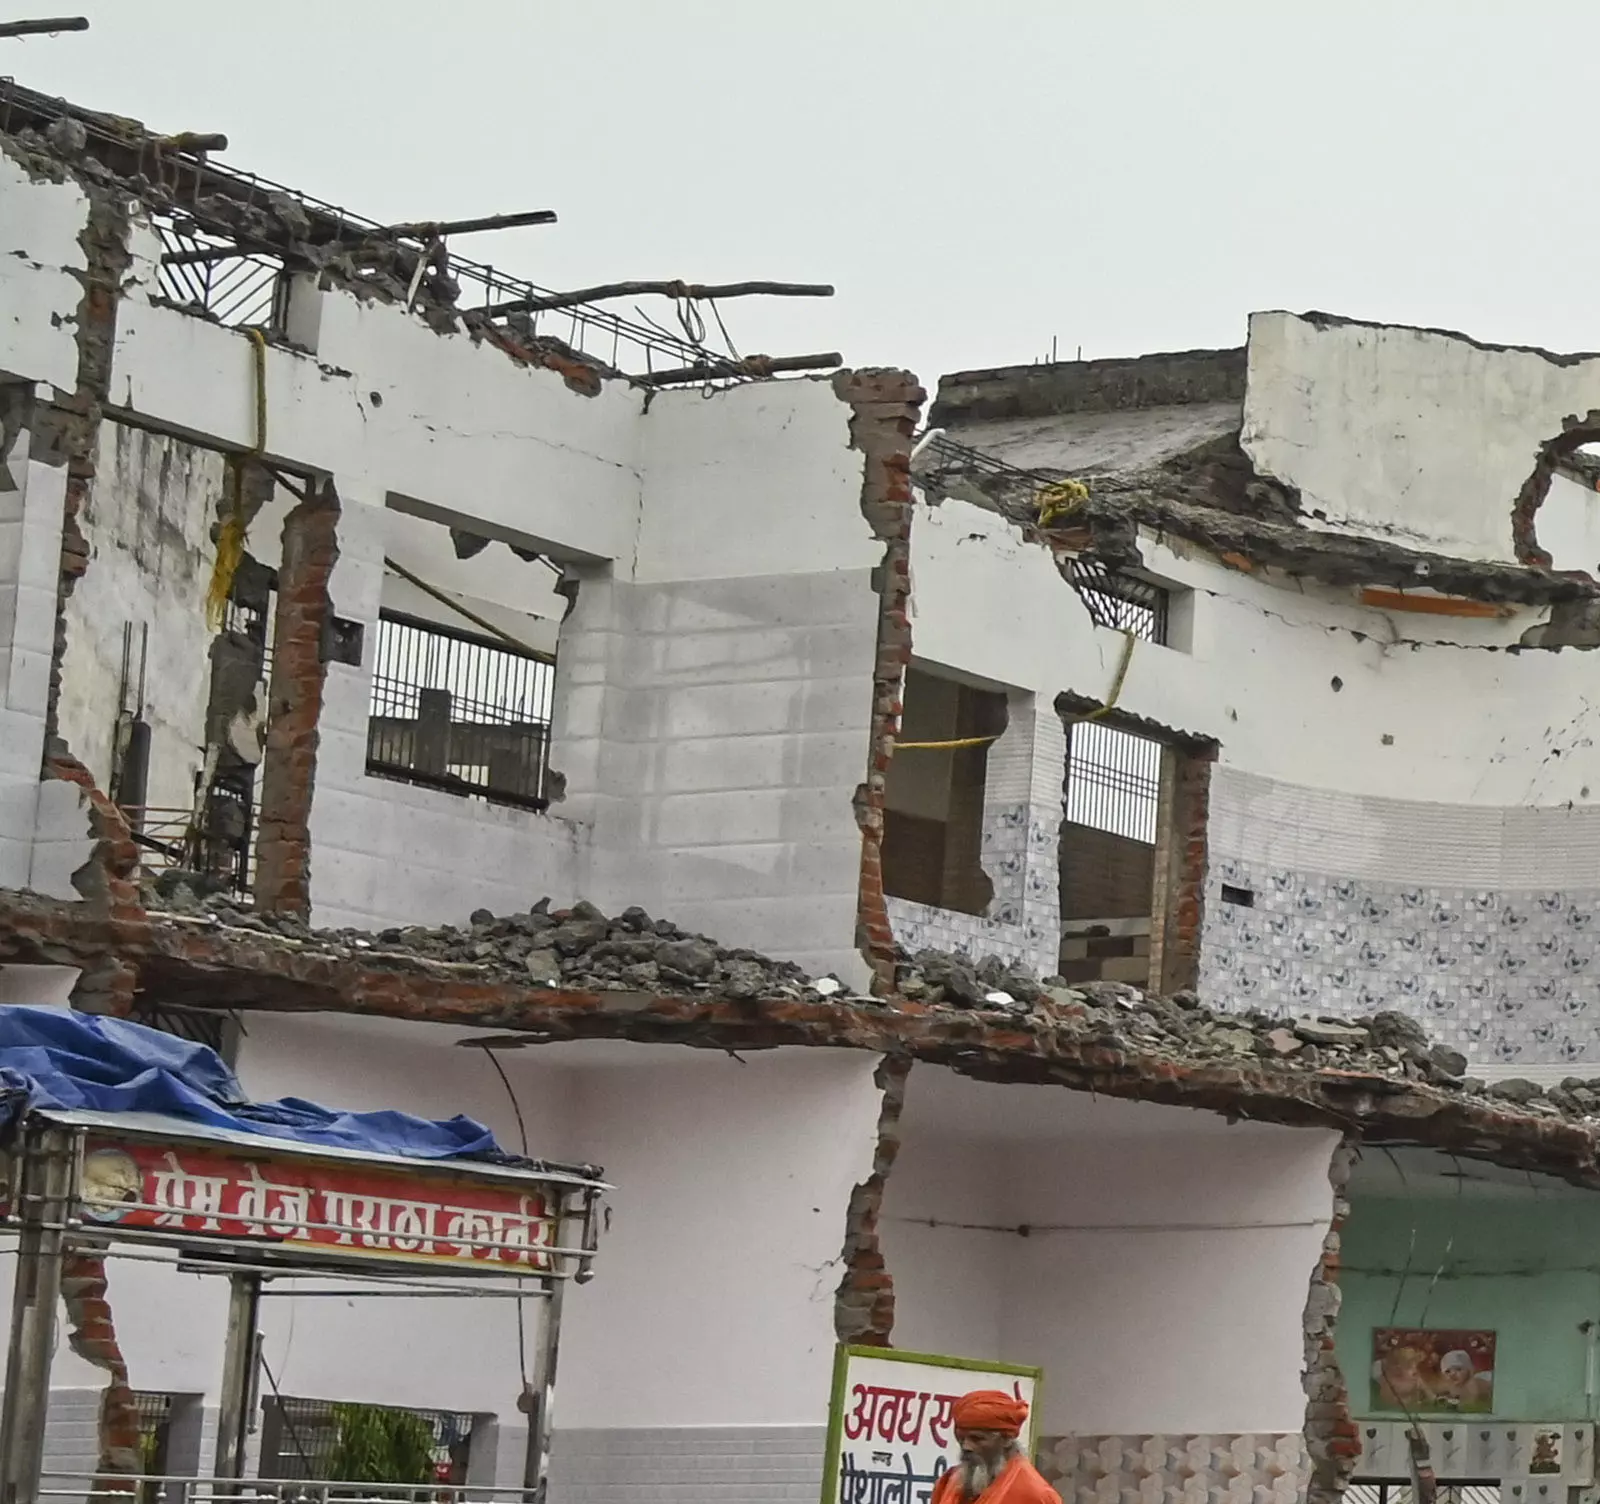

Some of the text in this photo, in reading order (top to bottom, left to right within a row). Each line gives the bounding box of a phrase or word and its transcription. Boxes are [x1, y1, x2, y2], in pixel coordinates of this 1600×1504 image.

[152, 1151, 229, 1232] प्रेम
[237, 1162, 314, 1240] वेज
[322, 1189, 443, 1253] पराठा
[844, 1383, 931, 1446] अवध
